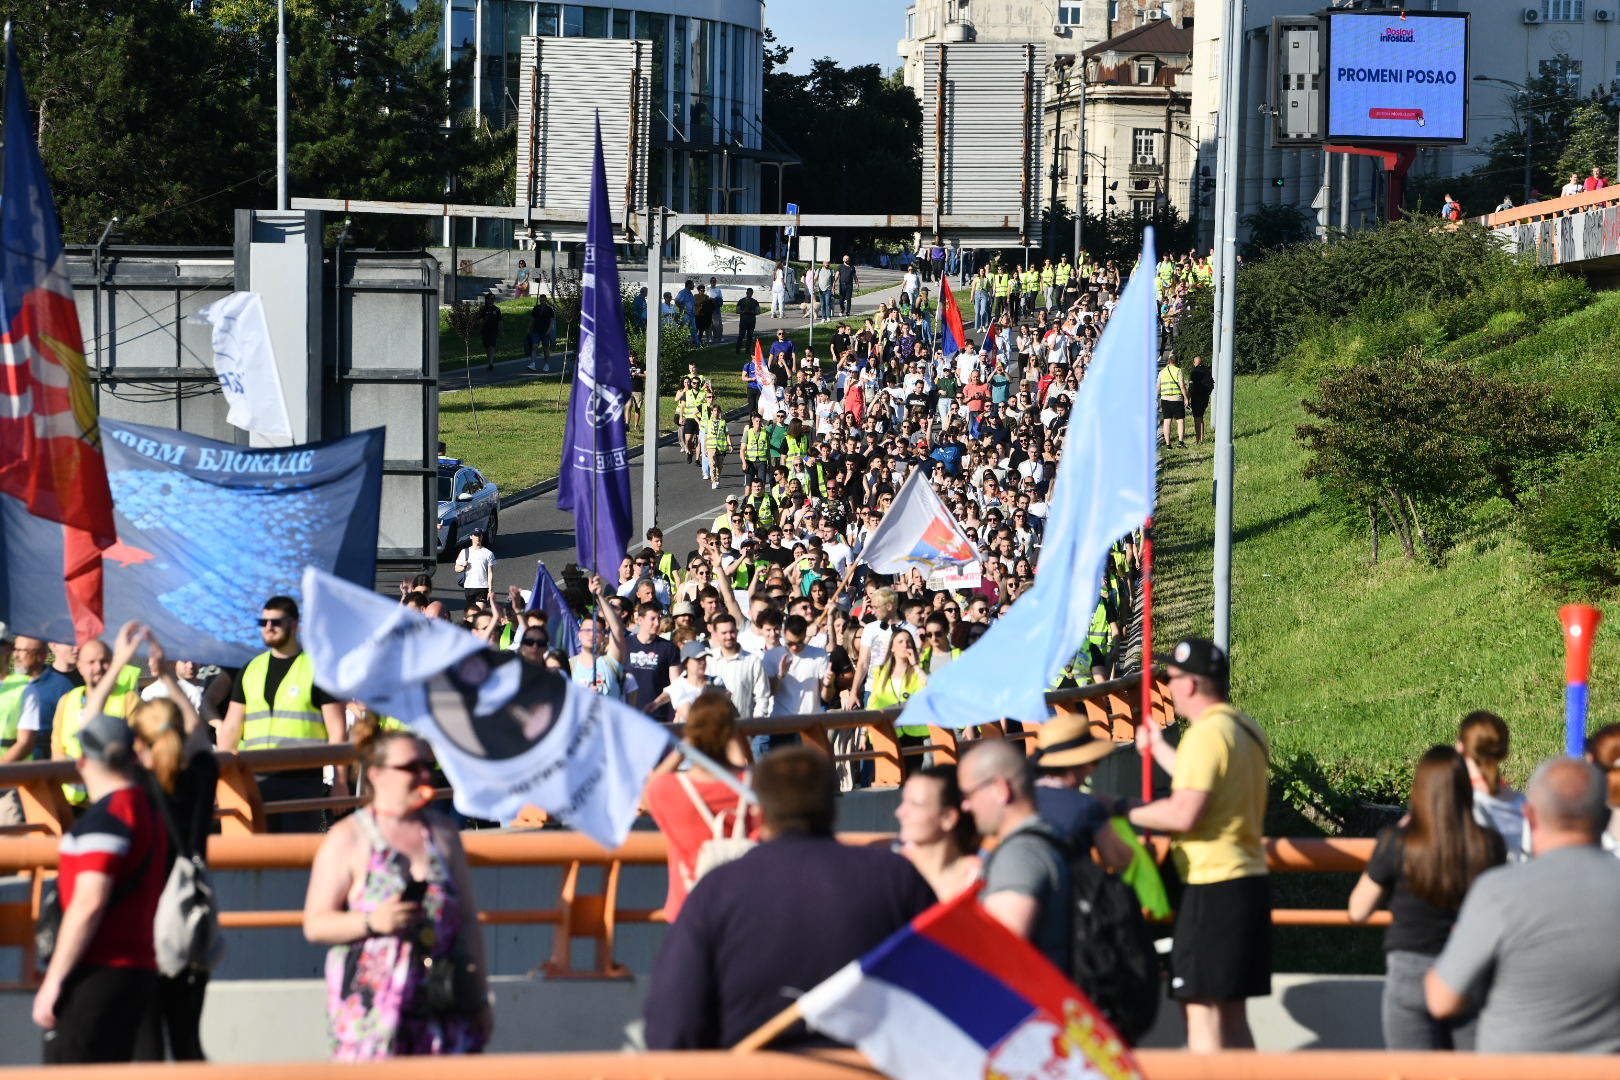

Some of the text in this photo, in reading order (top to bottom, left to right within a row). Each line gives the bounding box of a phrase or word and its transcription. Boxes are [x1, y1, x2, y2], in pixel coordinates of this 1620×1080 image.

[1386, 27, 1413, 35] Poslovi
[1337, 67, 1457, 84] PROMENI POSAO
[195, 447, 316, 476] БЛОКАДЕ
